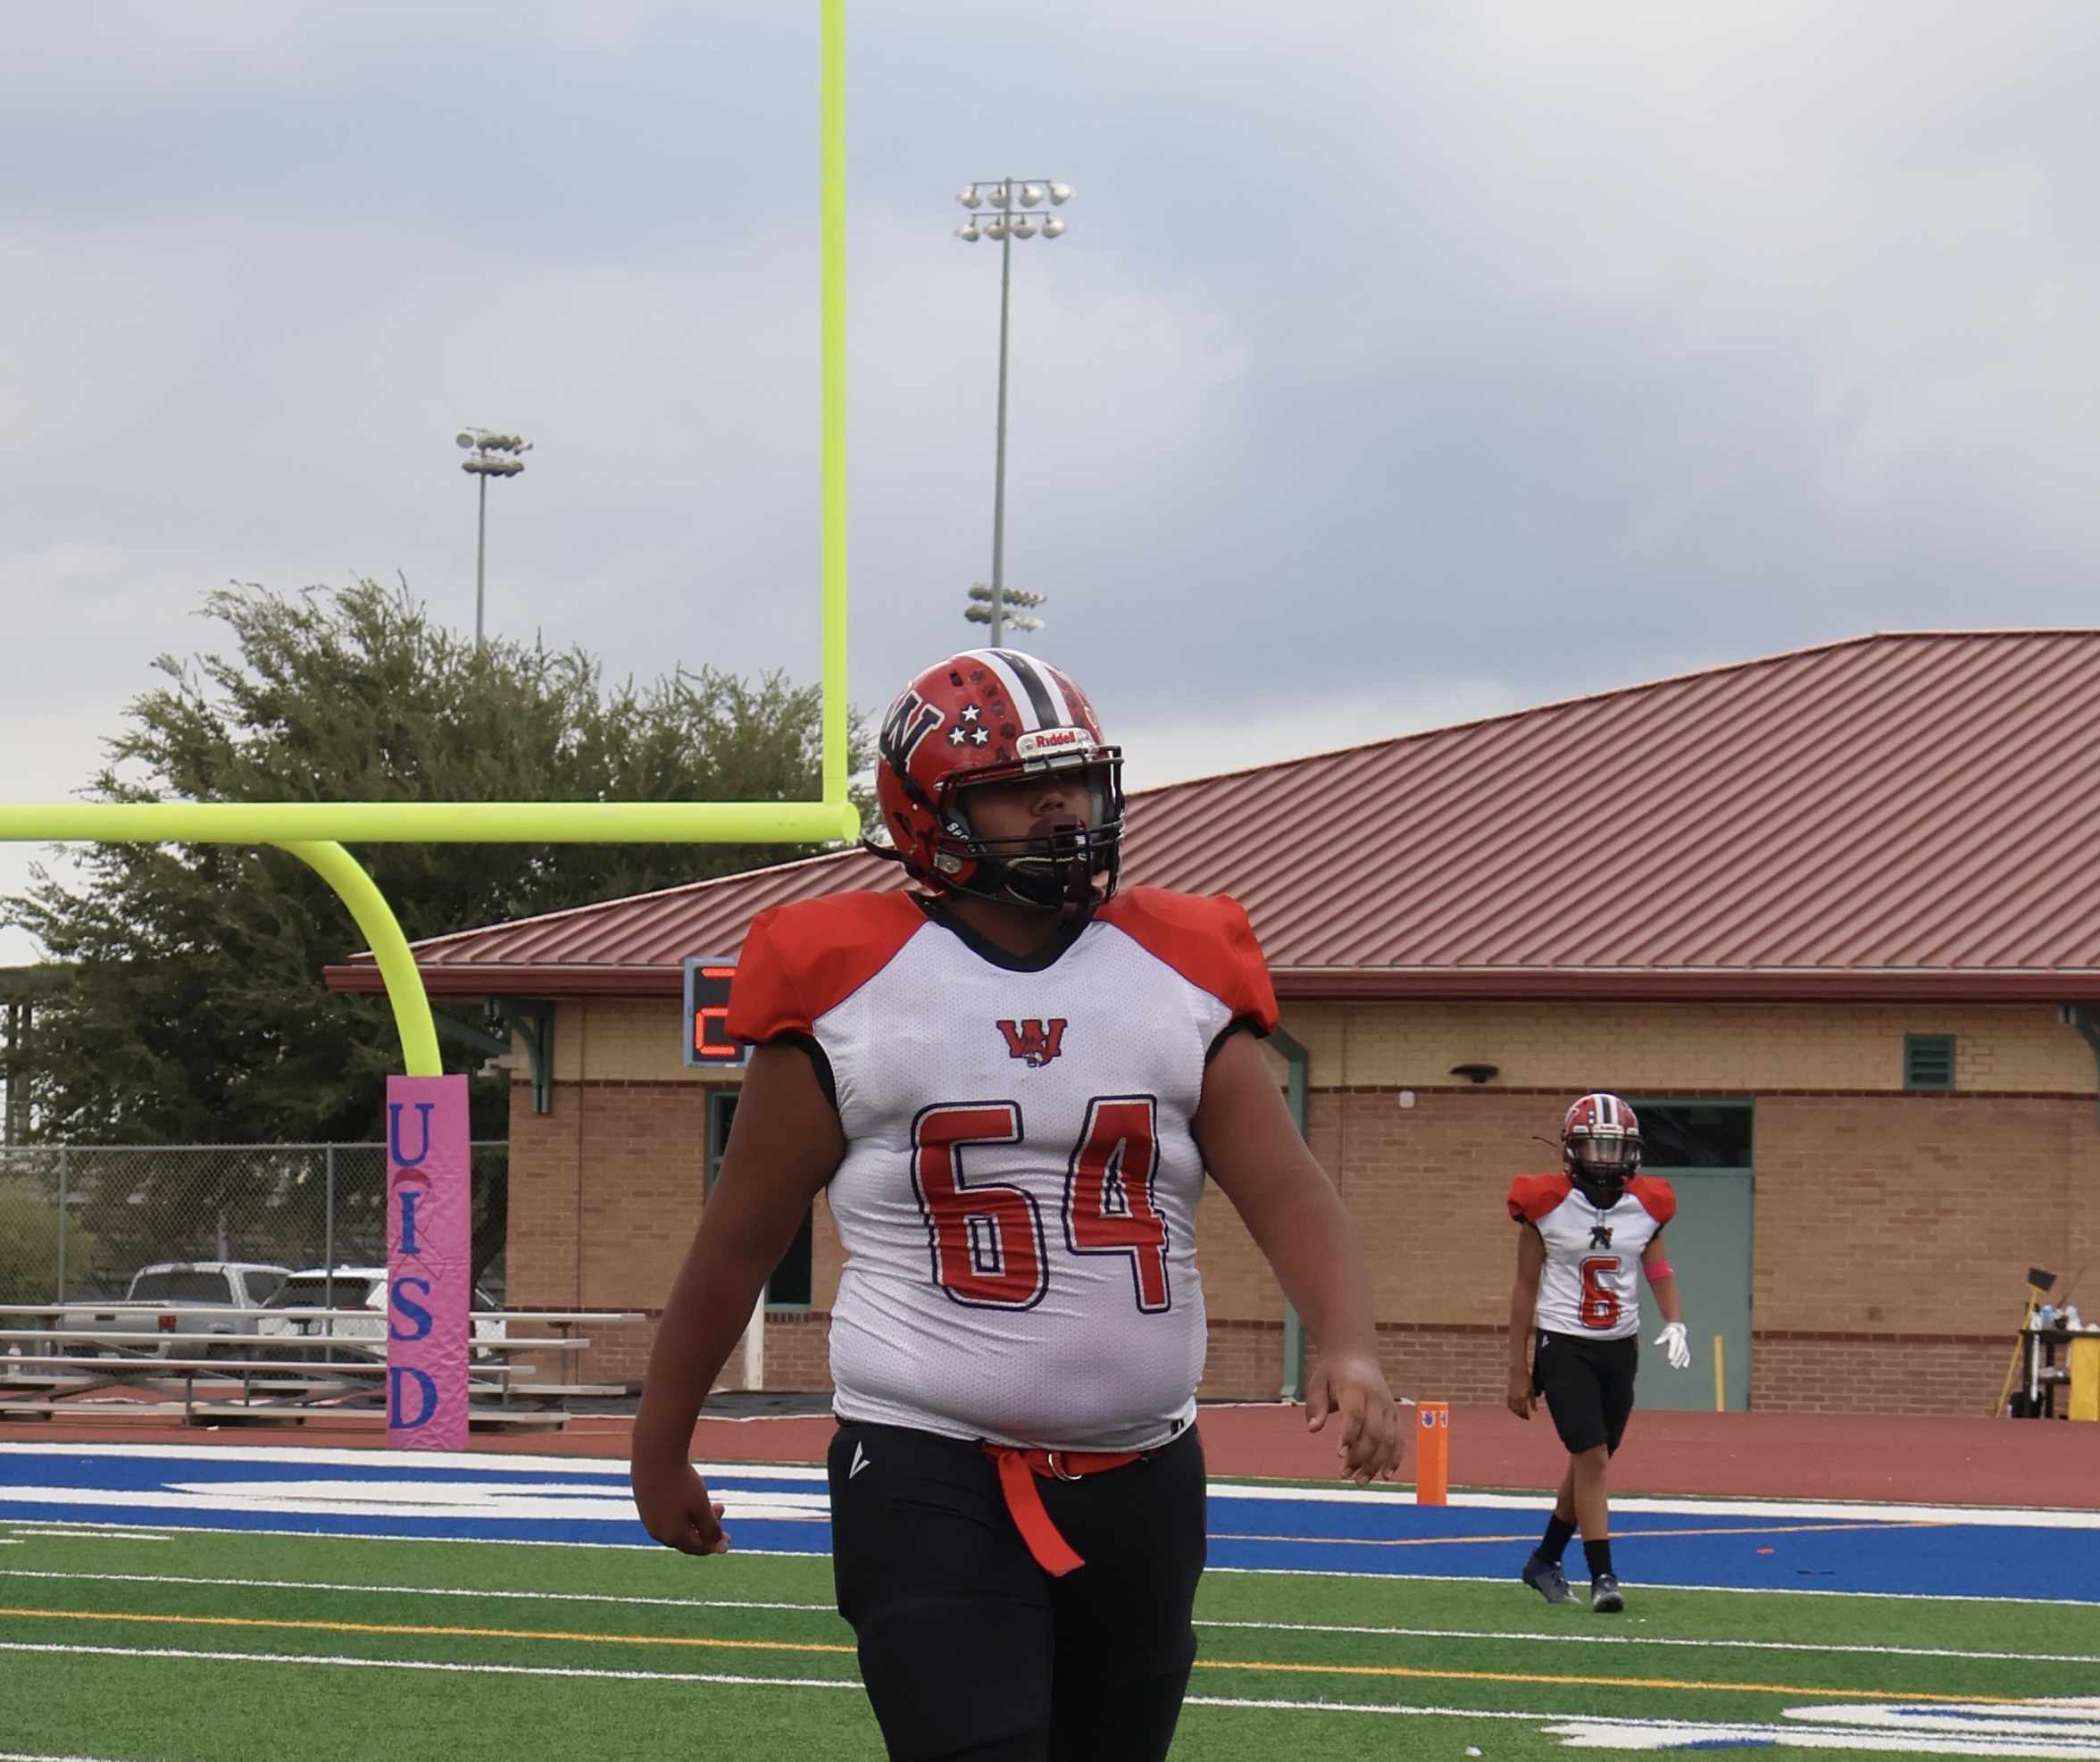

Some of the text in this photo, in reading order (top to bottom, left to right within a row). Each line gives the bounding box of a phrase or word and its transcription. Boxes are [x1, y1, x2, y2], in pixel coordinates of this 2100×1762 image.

[1036, 731, 1076, 747] Riddell
[388, 1103, 438, 1429] UISD
[910, 1094, 1171, 1315] 64
[1579, 1256, 1621, 1330] 6
